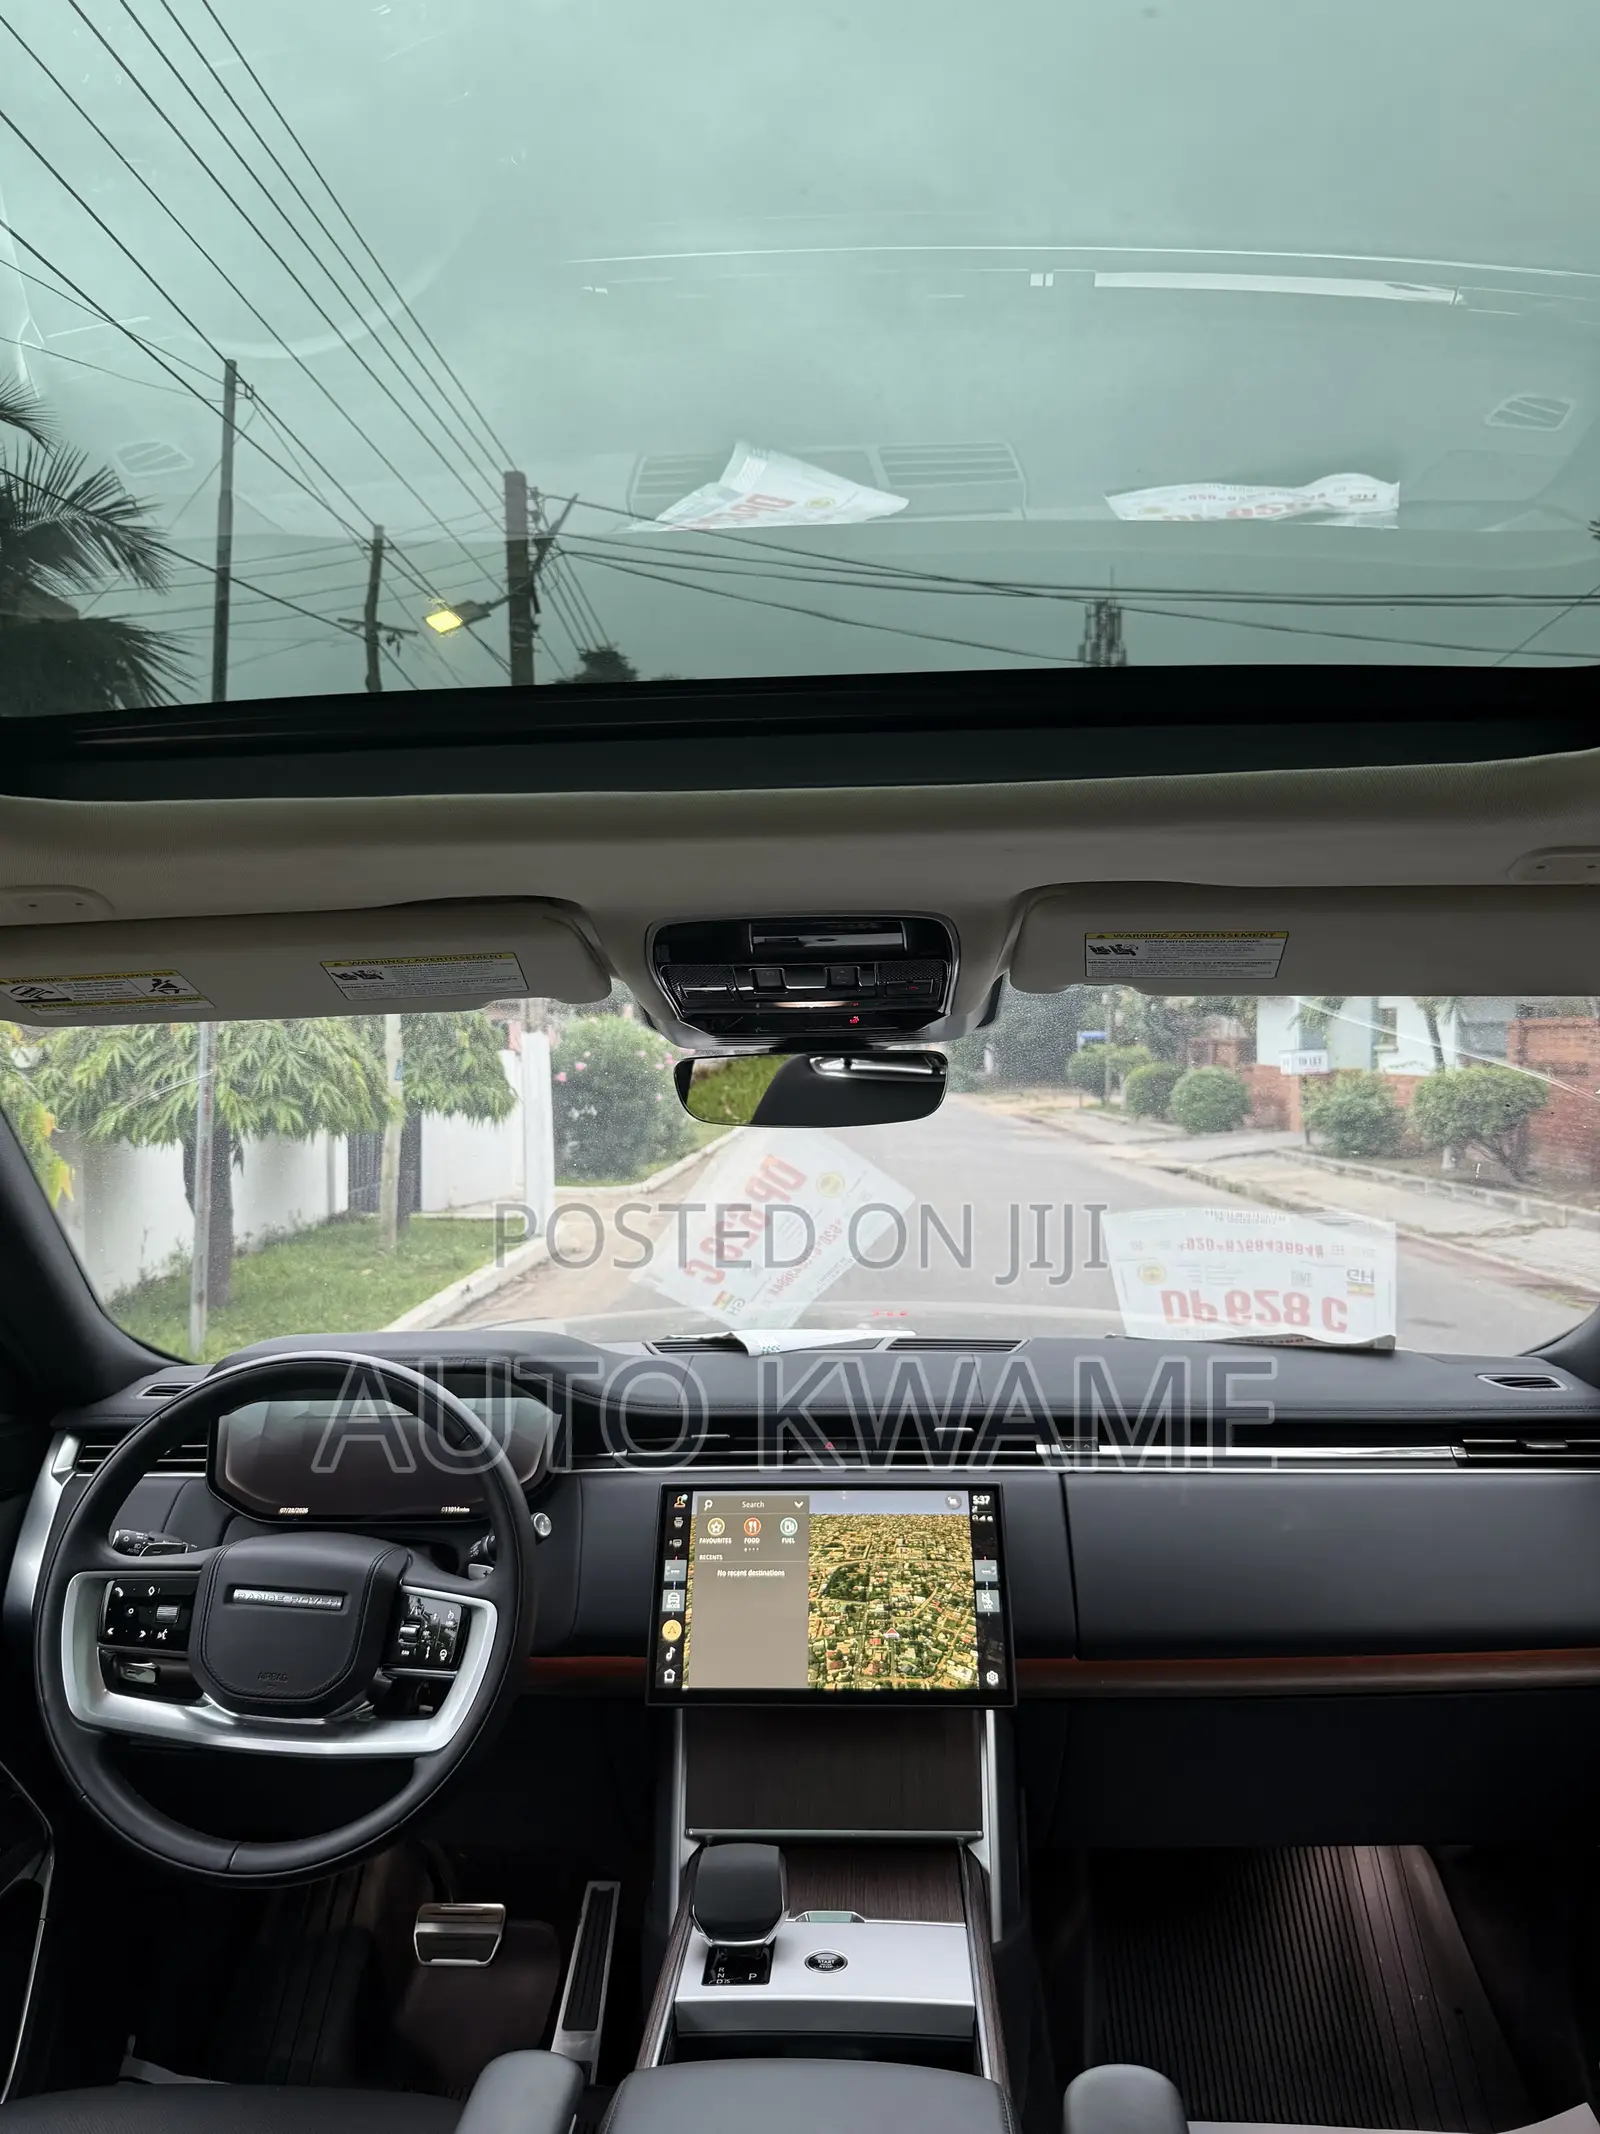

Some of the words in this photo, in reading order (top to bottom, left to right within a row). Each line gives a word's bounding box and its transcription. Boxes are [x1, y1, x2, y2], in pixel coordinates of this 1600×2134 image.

[1113, 931, 1170, 939] WARNING
[1180, 931, 1276, 939] AVERTISSEMENT
[349, 957, 404, 966] WARNING
[413, 952, 504, 963] AVERTISSEMENT
[741, 1500, 765, 1509] Search
[699, 1537, 732, 1545] FAVOURITES
[743, 1537, 761, 1545] FOOD
[781, 1537, 796, 1545] FUEL
[237, 1593, 286, 1602] RANGE
[257, 1673, 288, 1683] AIRBAG
